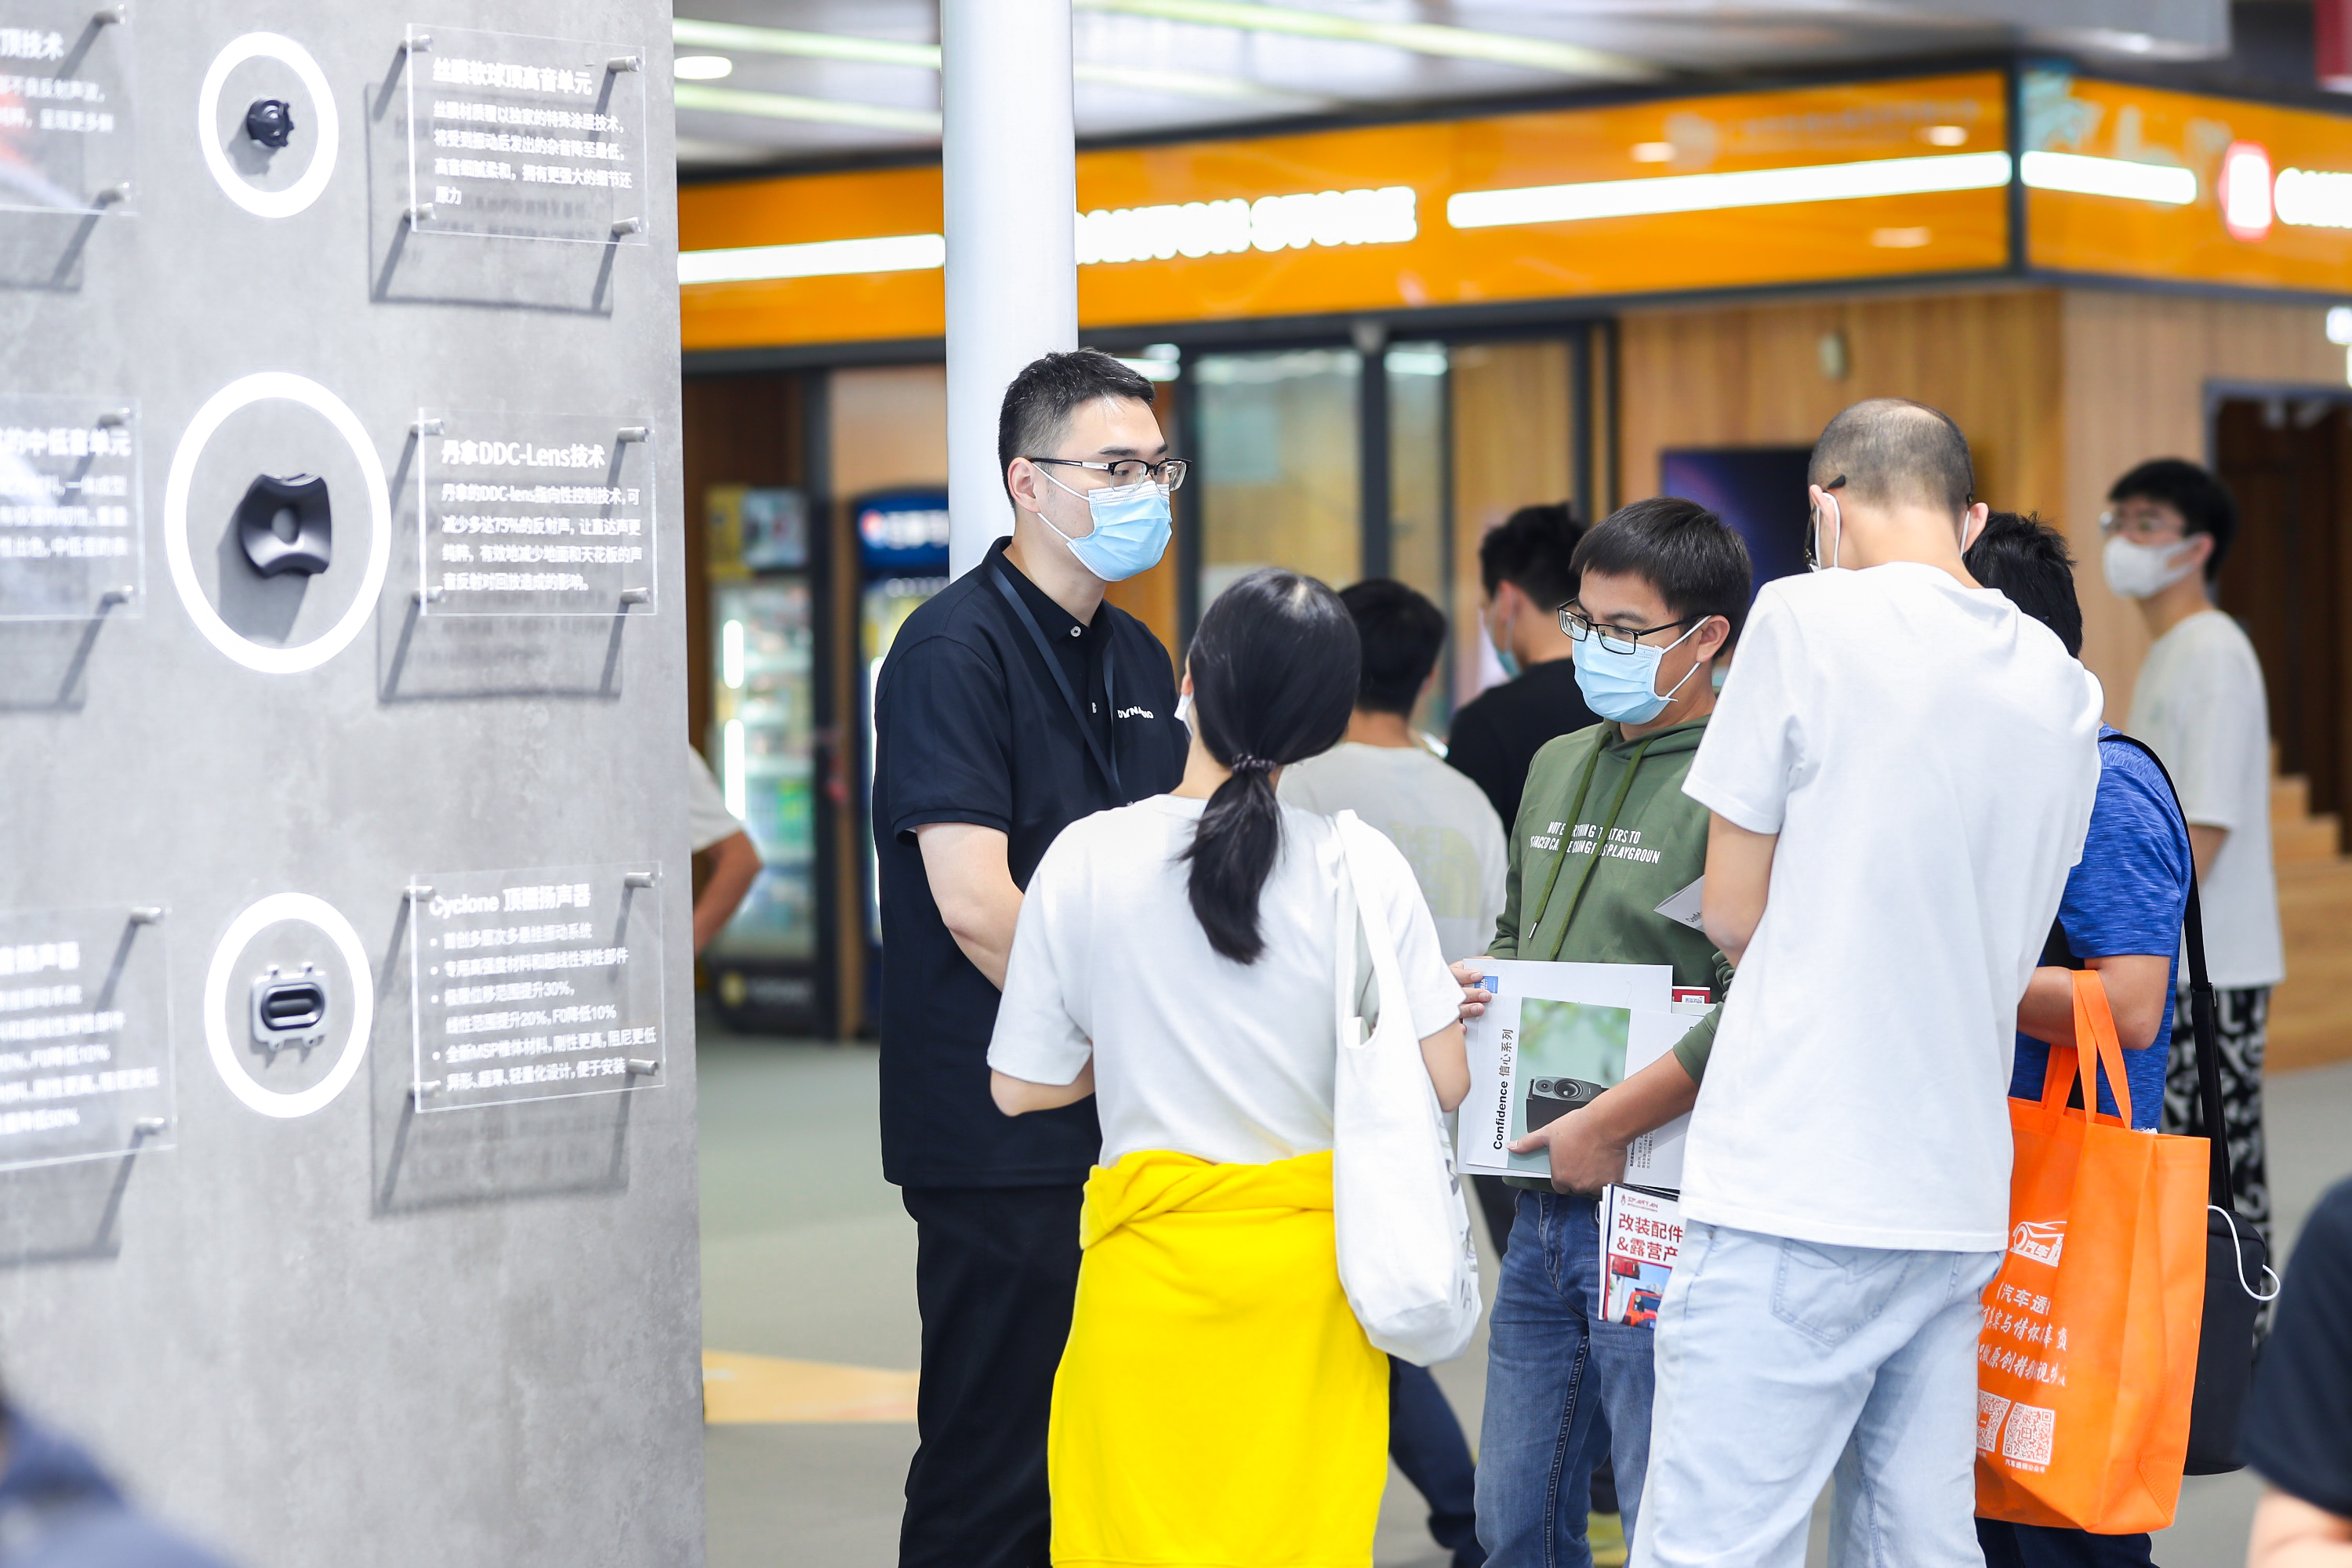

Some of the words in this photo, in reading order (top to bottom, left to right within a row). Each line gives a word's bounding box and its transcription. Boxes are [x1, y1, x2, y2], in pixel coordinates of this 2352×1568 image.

[441, 440, 606, 468] 丹拿DDC-Lens技术
[1547, 822, 1562, 834] NOT
[1628, 831, 1641, 844] TO
[429, 894, 500, 919] Cyclone
[1498, 1029, 1514, 1077] 信心系列
[1493, 1080, 1508, 1150] Confidence
[1618, 1212, 1683, 1243] 改装配件
[1617, 1236, 1679, 1261] &露营产
